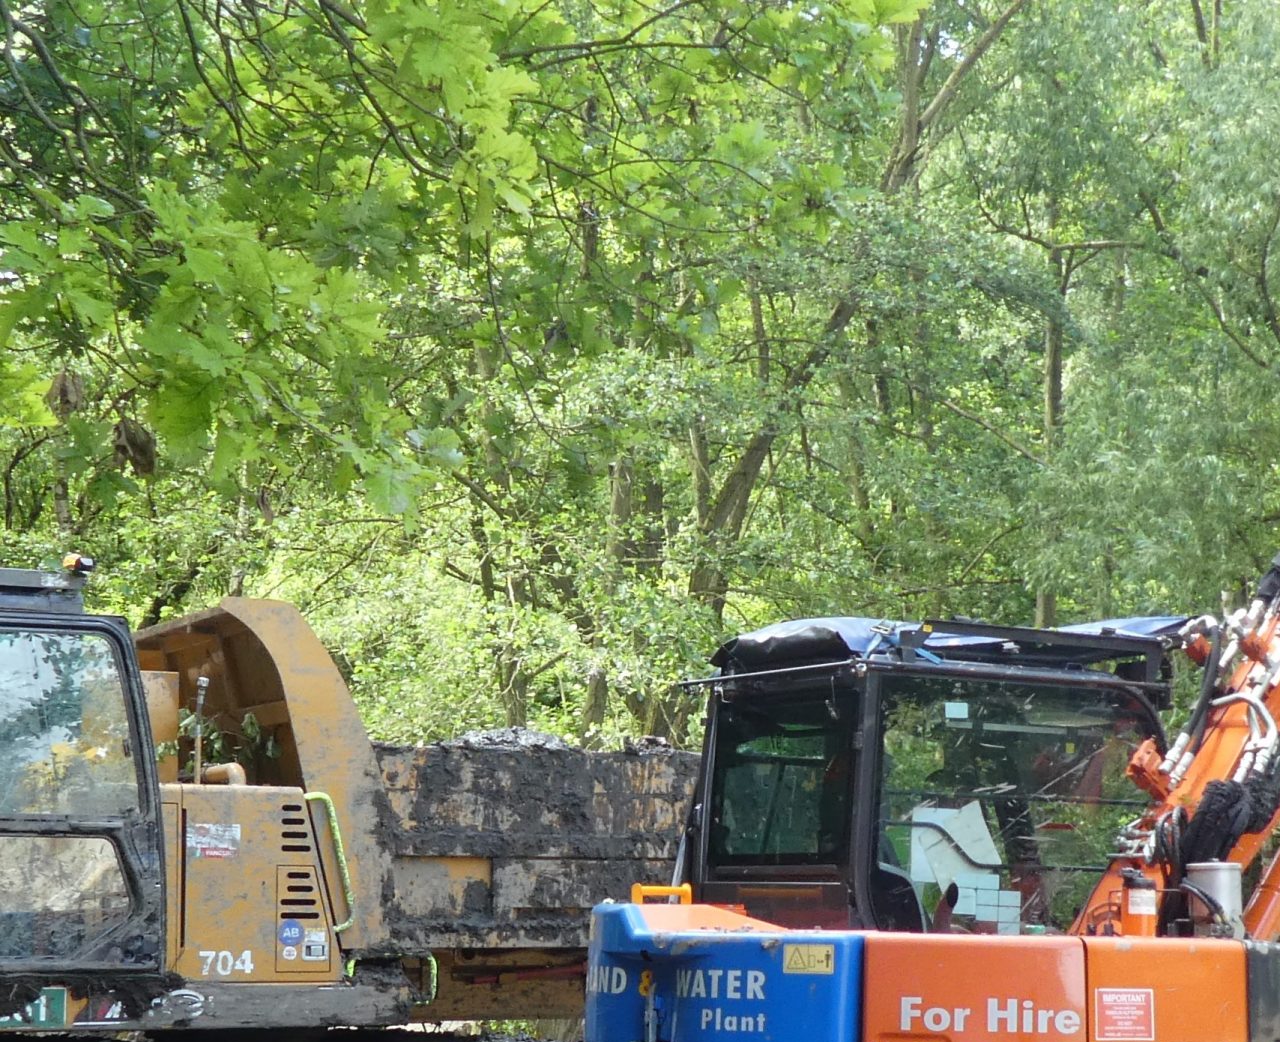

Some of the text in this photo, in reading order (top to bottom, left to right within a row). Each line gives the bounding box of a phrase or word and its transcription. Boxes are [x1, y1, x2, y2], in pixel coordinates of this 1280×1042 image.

[283, 927, 300, 938] AB
[199, 950, 254, 976] 704
[676, 969, 766, 1000] WATER
[1102, 994, 1146, 1003] IMPORTANT
[701, 1008, 766, 1033] Plant
[900, 996, 1081, 1034] For Hire
